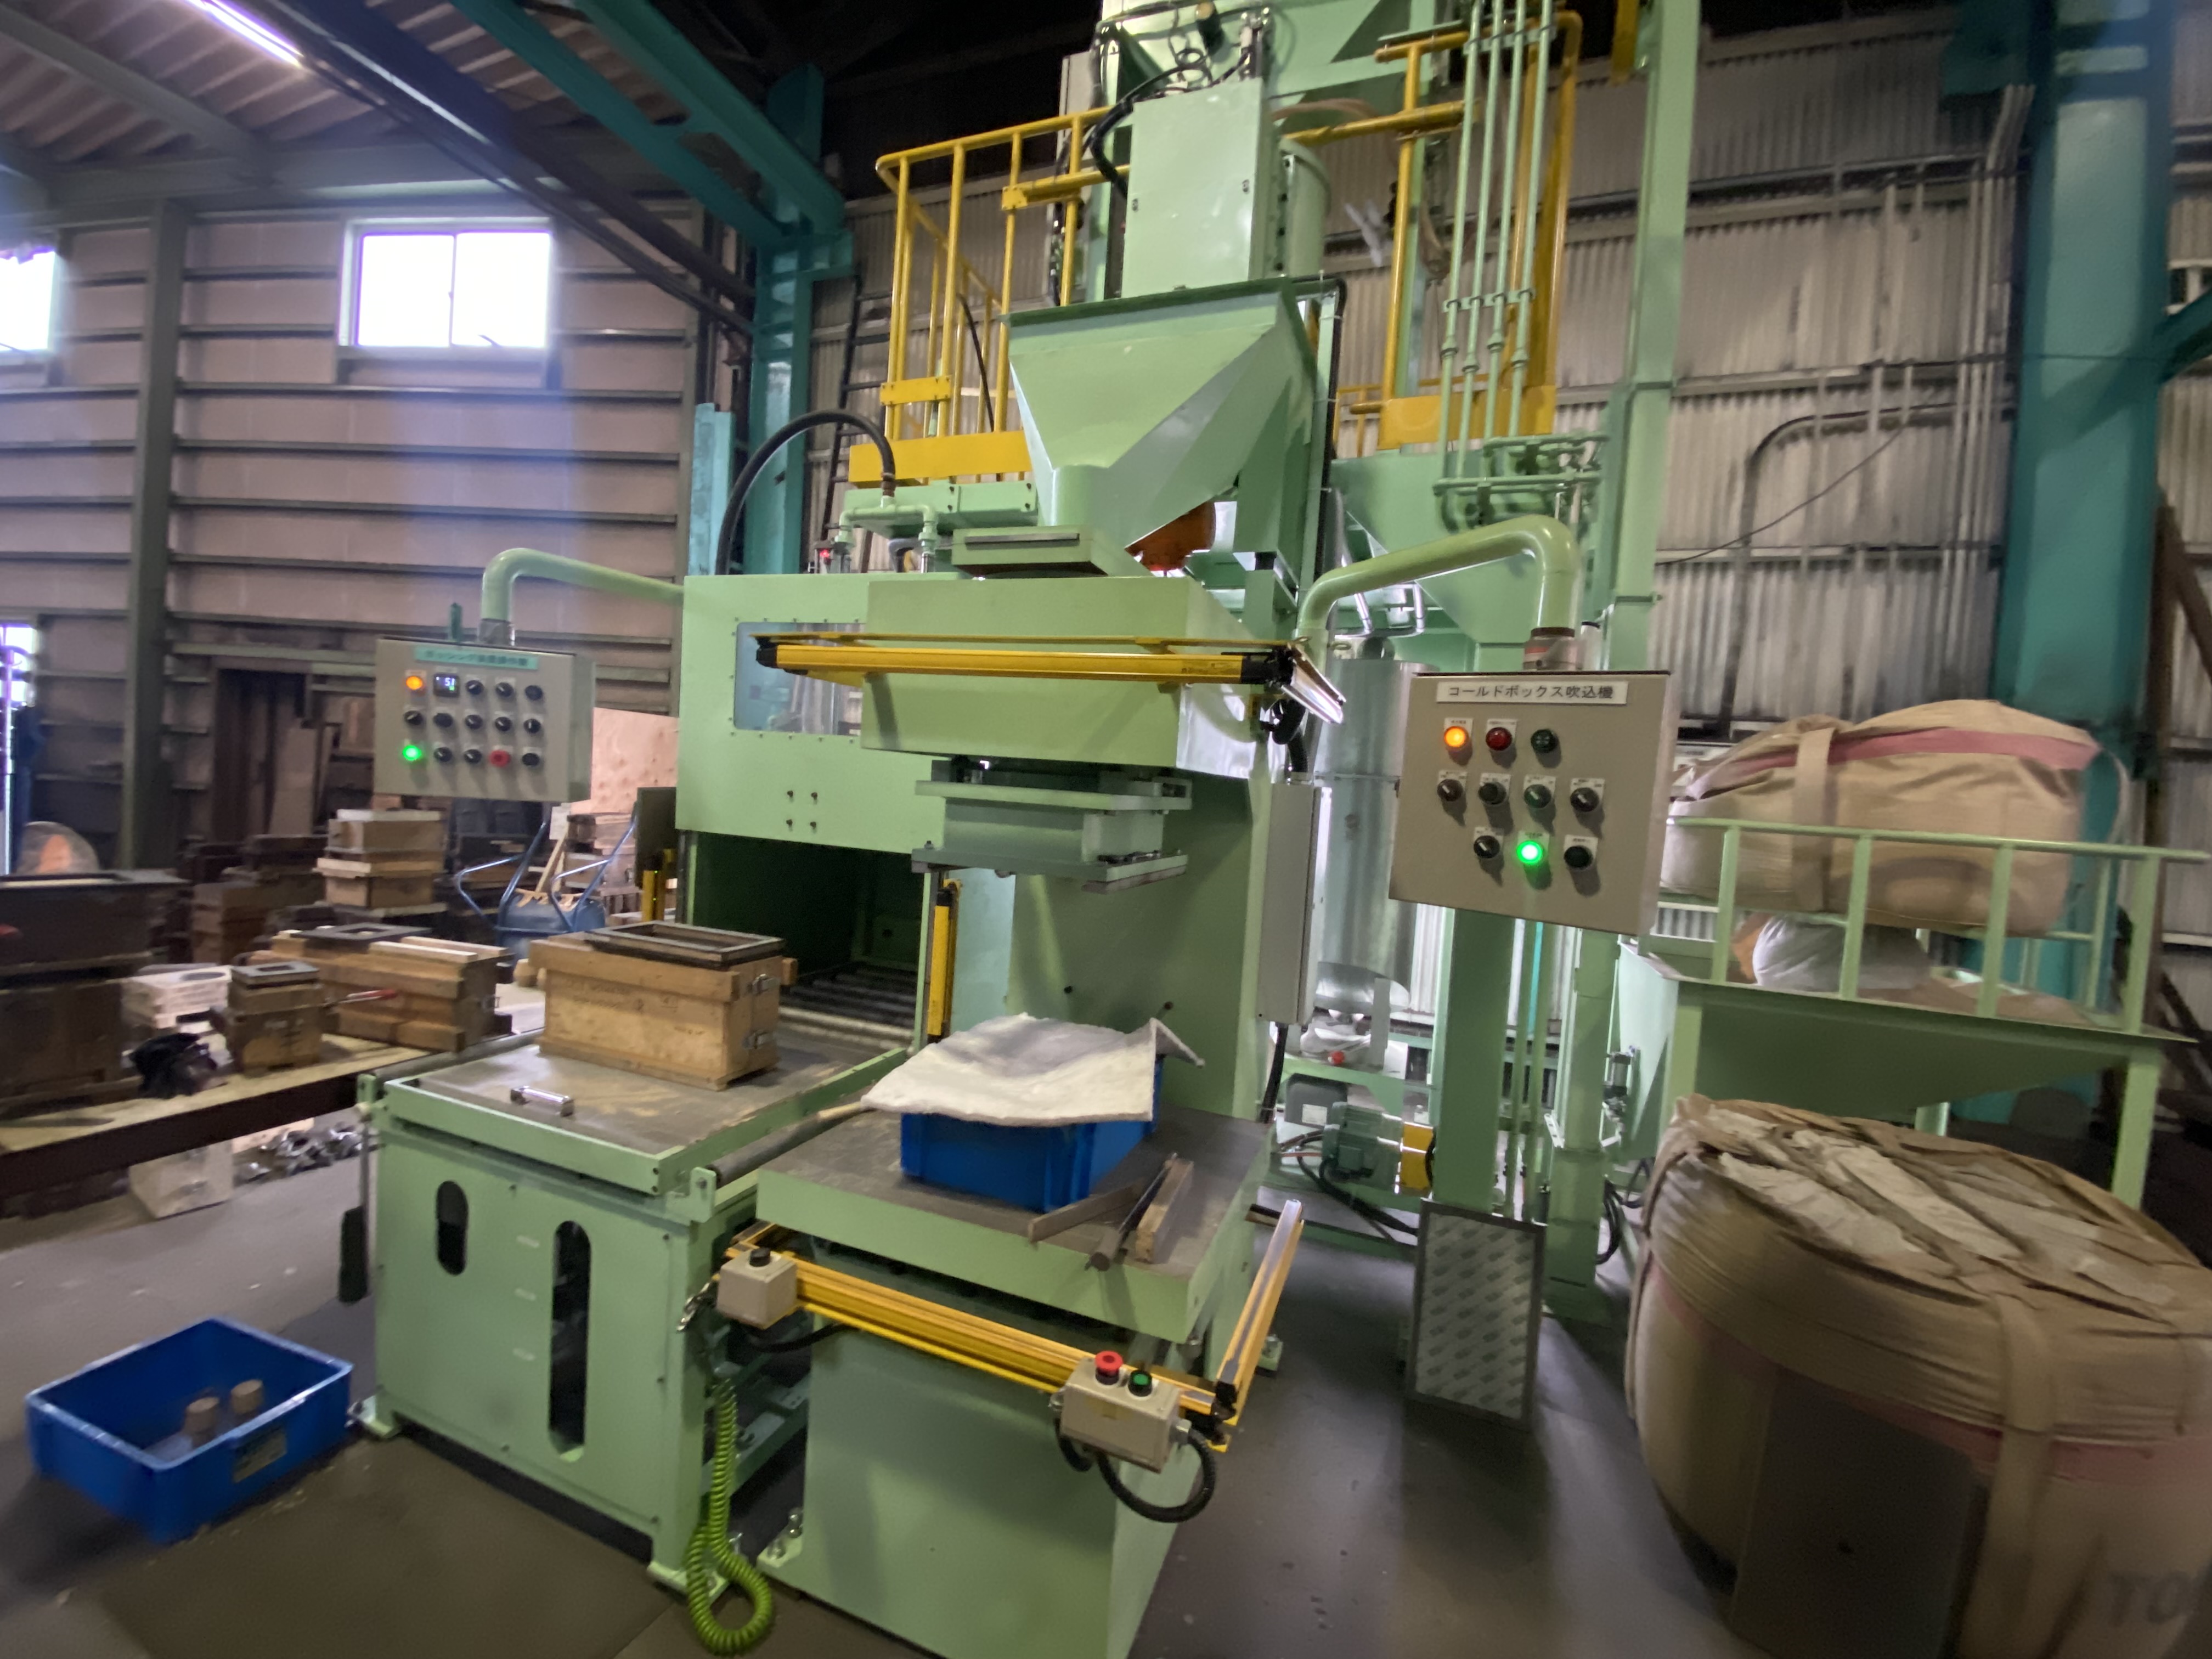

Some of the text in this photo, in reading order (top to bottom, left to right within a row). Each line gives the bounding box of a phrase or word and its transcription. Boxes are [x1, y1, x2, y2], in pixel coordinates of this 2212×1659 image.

[1449, 684, 1613, 699] コールドボックス吹込機
